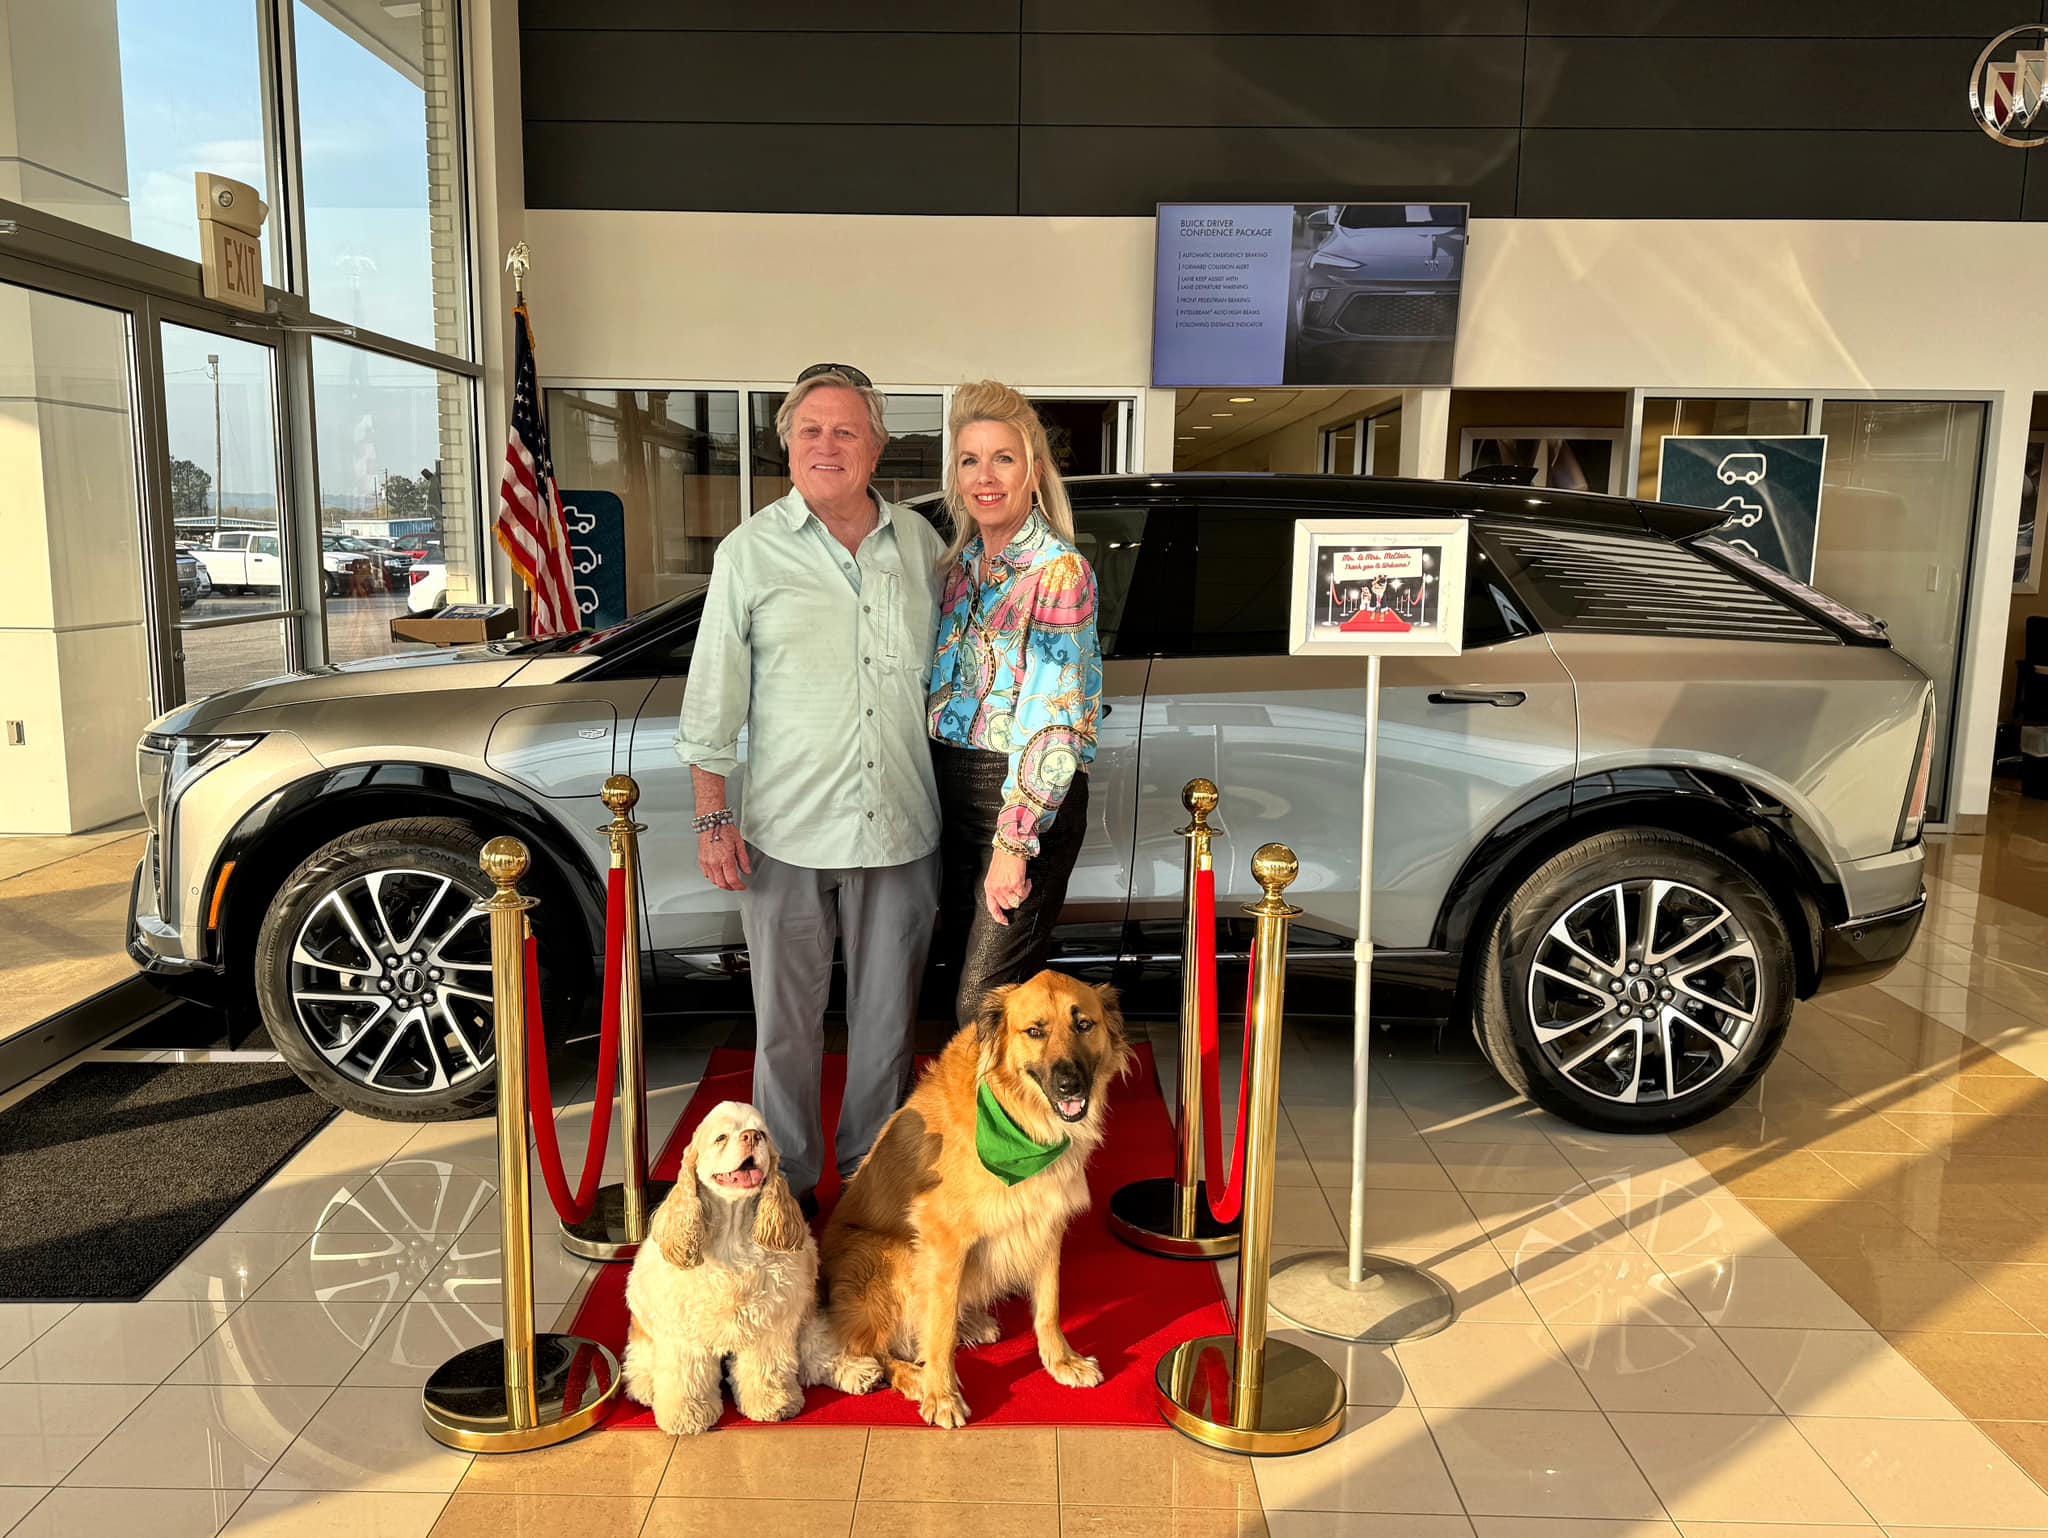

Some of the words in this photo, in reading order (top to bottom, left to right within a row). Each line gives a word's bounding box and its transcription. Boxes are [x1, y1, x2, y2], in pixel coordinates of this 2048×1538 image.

[1180, 219, 1204, 228] BUICK
[1206, 219, 1234, 228] DRIVER
[1180, 228, 1233, 237] CONFIDENCE
[1235, 228, 1273, 237] PACKAGE
[223, 236, 256, 298] EXIT
[1381, 560, 1411, 568] Welcome!
